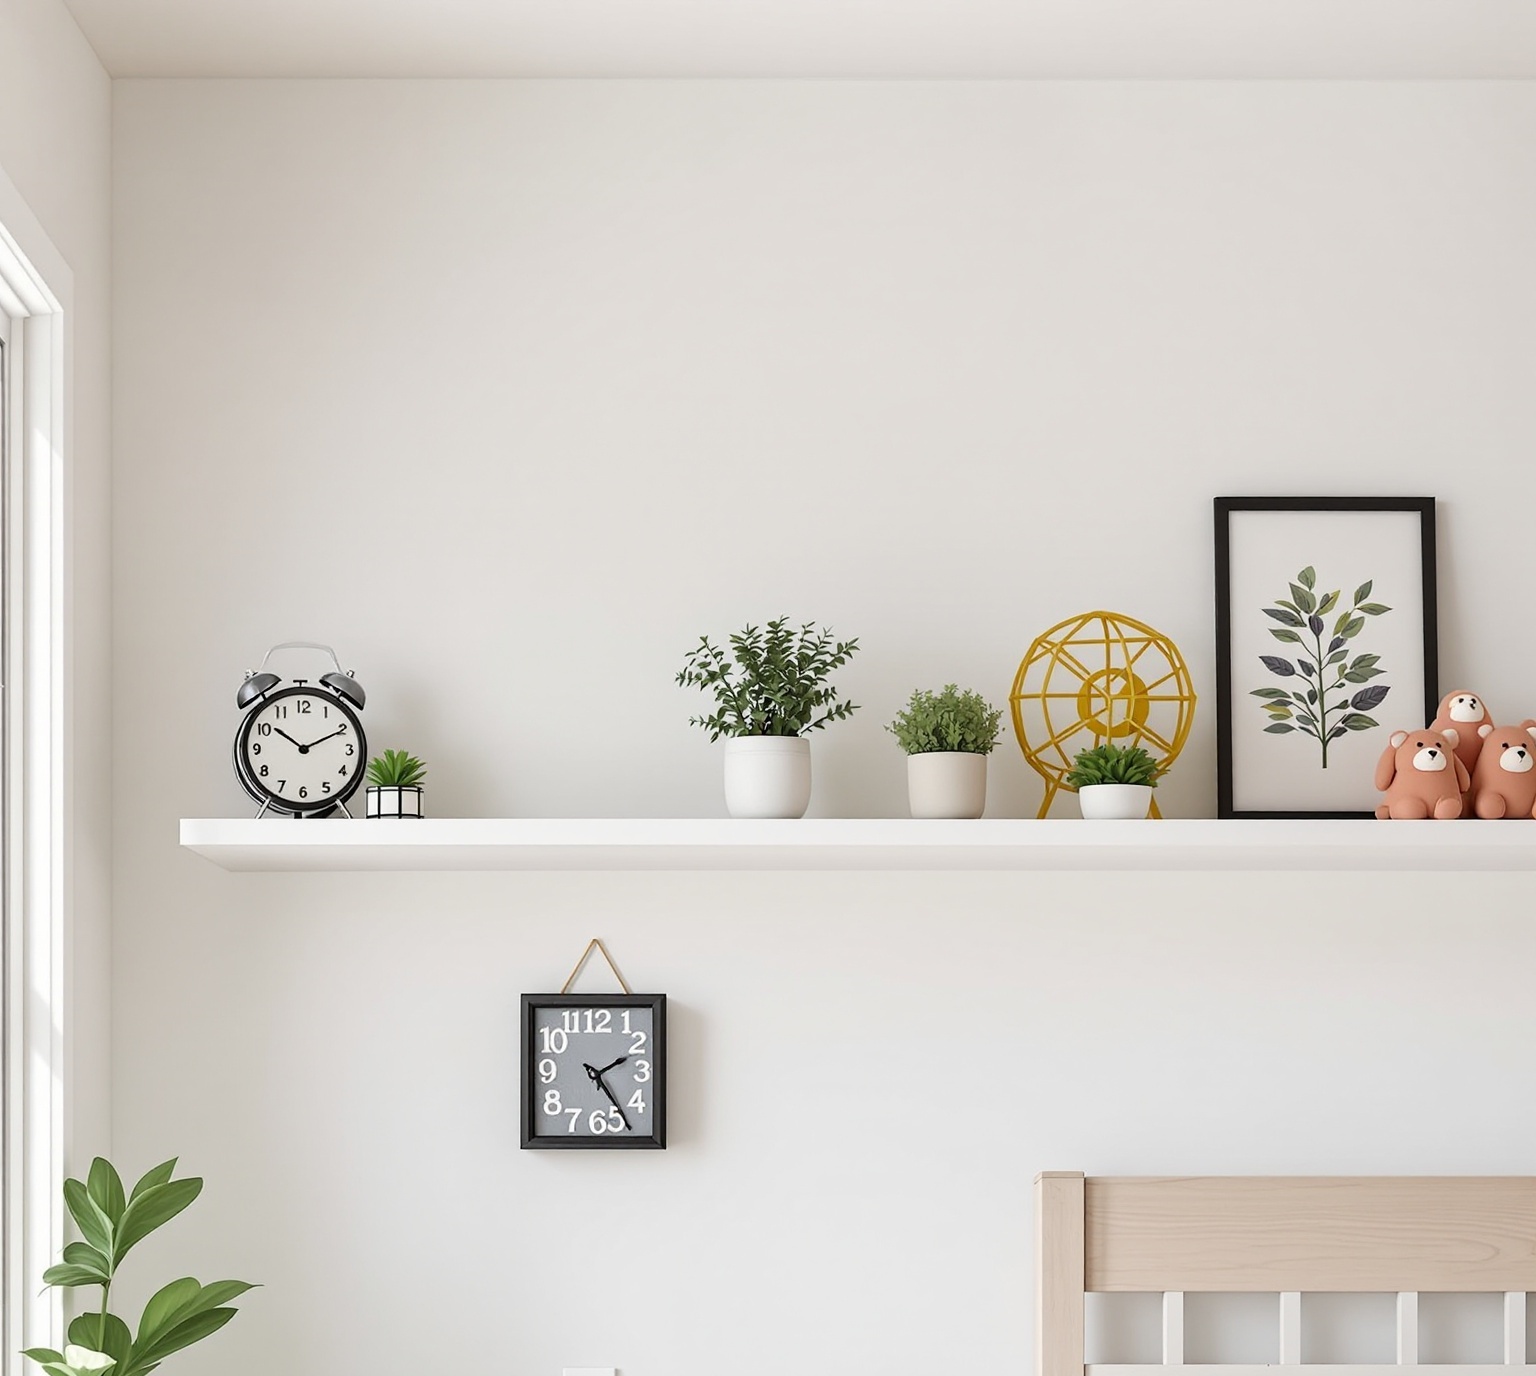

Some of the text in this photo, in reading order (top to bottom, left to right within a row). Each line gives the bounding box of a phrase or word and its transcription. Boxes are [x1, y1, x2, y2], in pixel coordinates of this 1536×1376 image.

[275, 704, 287, 719] 11
[297, 700, 311, 713] 12
[323, 706, 328, 718] 1
[257, 723, 271, 736] 10
[338, 723, 347, 735] 2
[253, 743, 261, 755] 9
[345, 744, 354, 756] 3
[259, 765, 269, 777] 8
[338, 765, 348, 776] 4
[277, 780, 286, 793] 7
[299, 786, 307, 798] 6
[322, 782, 331, 793] 5
[562, 1010, 580, 1033] 11
[583, 1009, 612, 1034] 12
[621, 1010, 632, 1034] 1
[539, 1026, 568, 1054] 10
[628, 1031, 647, 1054] 2
[539, 1059, 557, 1083] 9
[633, 1060, 650, 1082] 3
[543, 1090, 562, 1115] 8
[627, 1089, 646, 1113] 4
[564, 1108, 583, 1133] 7
[589, 1110, 607, 1134] 6
[607, 1105, 626, 1133] 5
